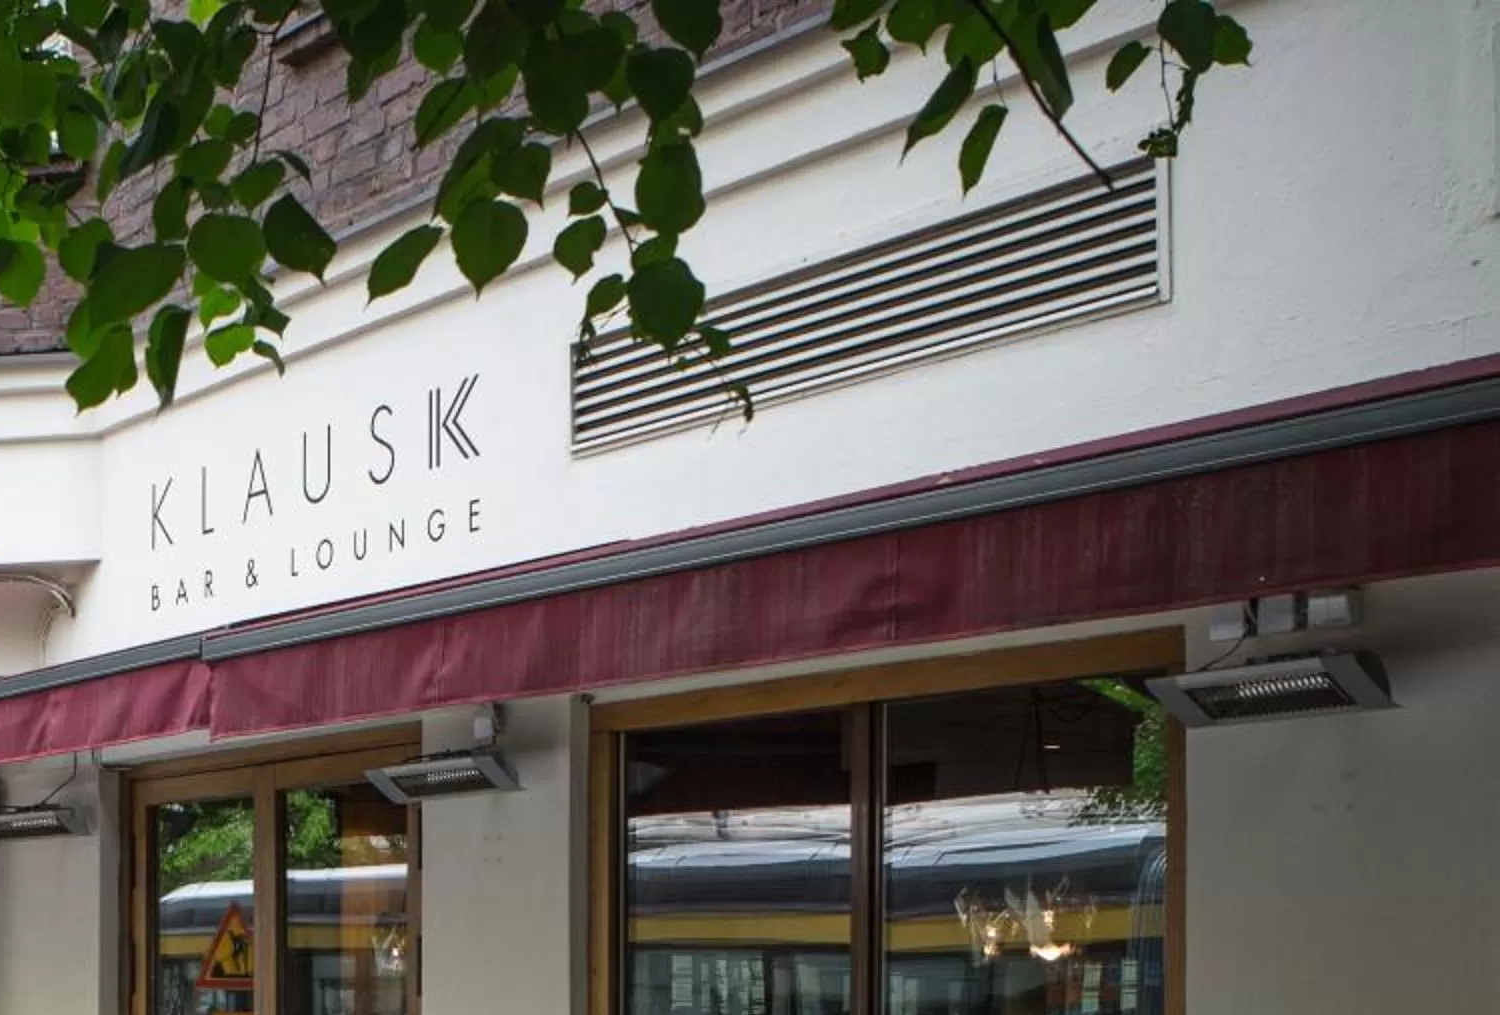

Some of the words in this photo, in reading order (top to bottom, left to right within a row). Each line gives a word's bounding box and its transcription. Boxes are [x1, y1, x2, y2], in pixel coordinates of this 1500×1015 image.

[151, 569, 215, 612] BAR
[245, 559, 259, 588] &
[290, 498, 482, 577] LOUNGE
